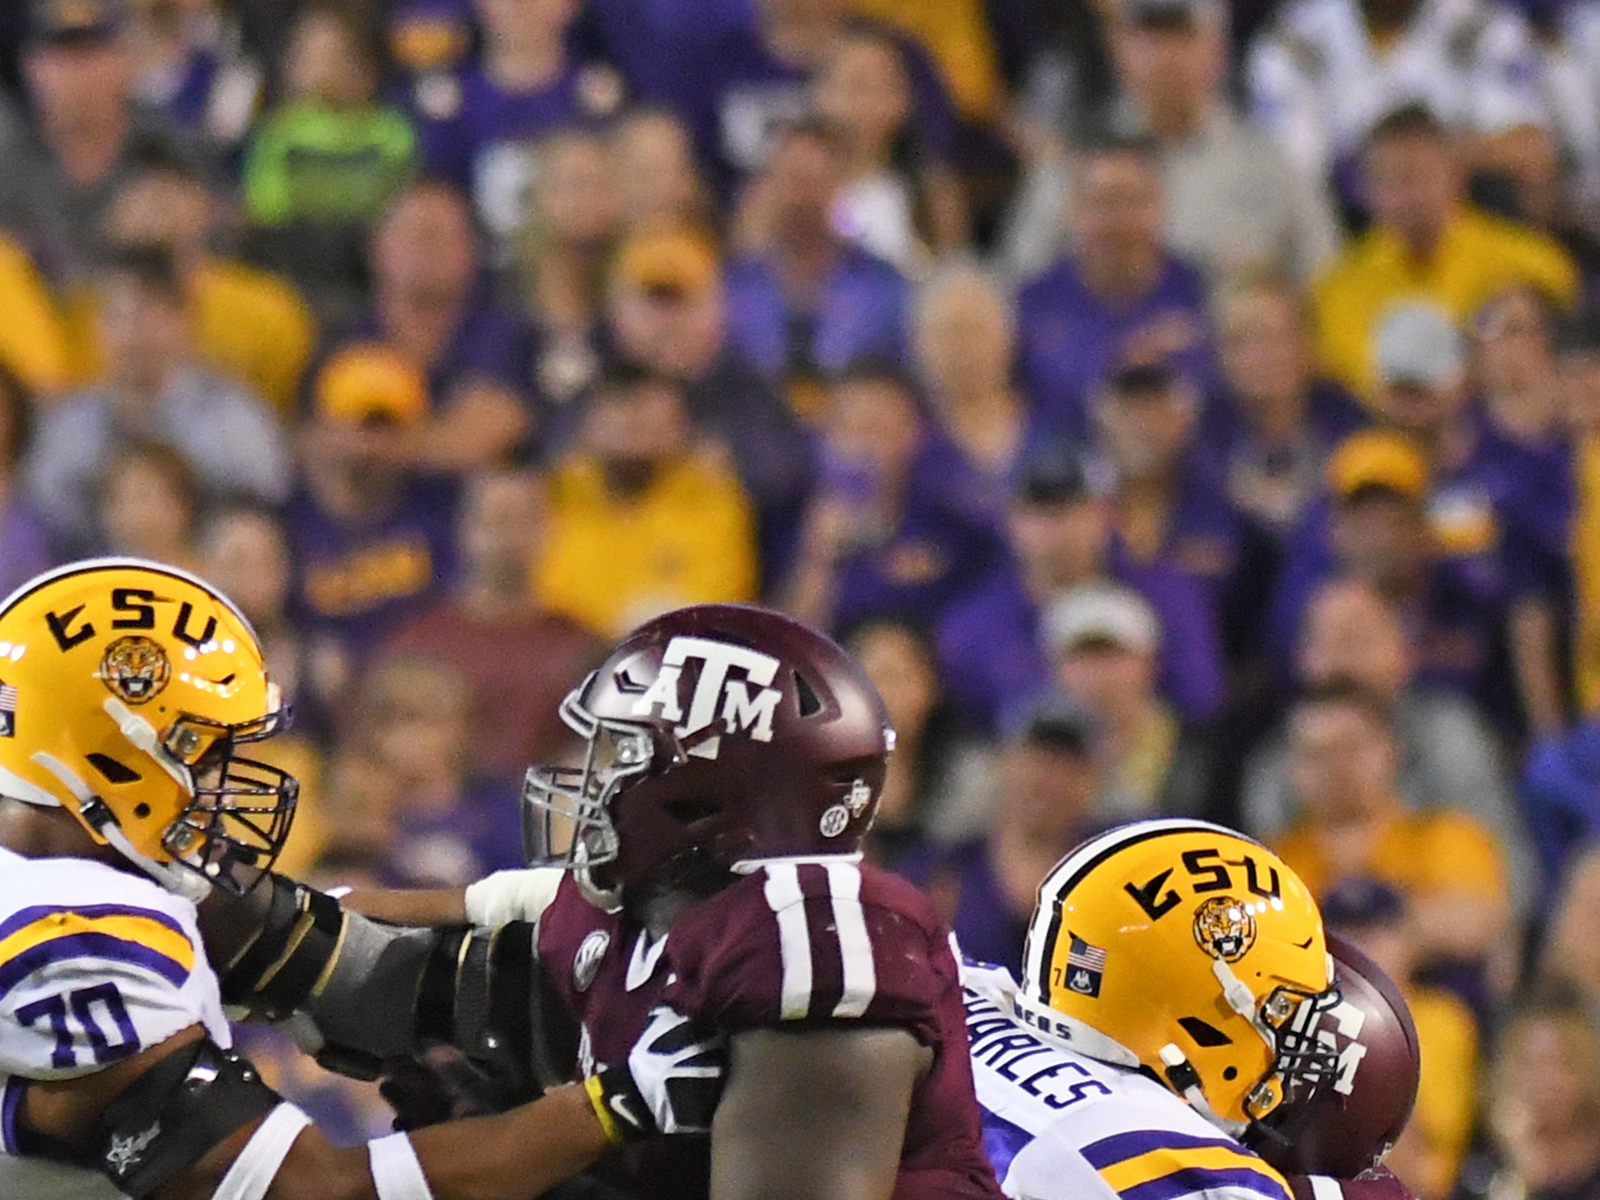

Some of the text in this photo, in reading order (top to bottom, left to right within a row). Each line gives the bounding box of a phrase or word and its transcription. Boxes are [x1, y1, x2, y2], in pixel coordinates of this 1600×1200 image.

[45, 587, 217, 654] LSU
[1123, 848, 1283, 922] LSU
[1053, 966, 1063, 988] 7
[13, 981, 142, 1070] 70
[963, 986, 1113, 1110] HARLES
